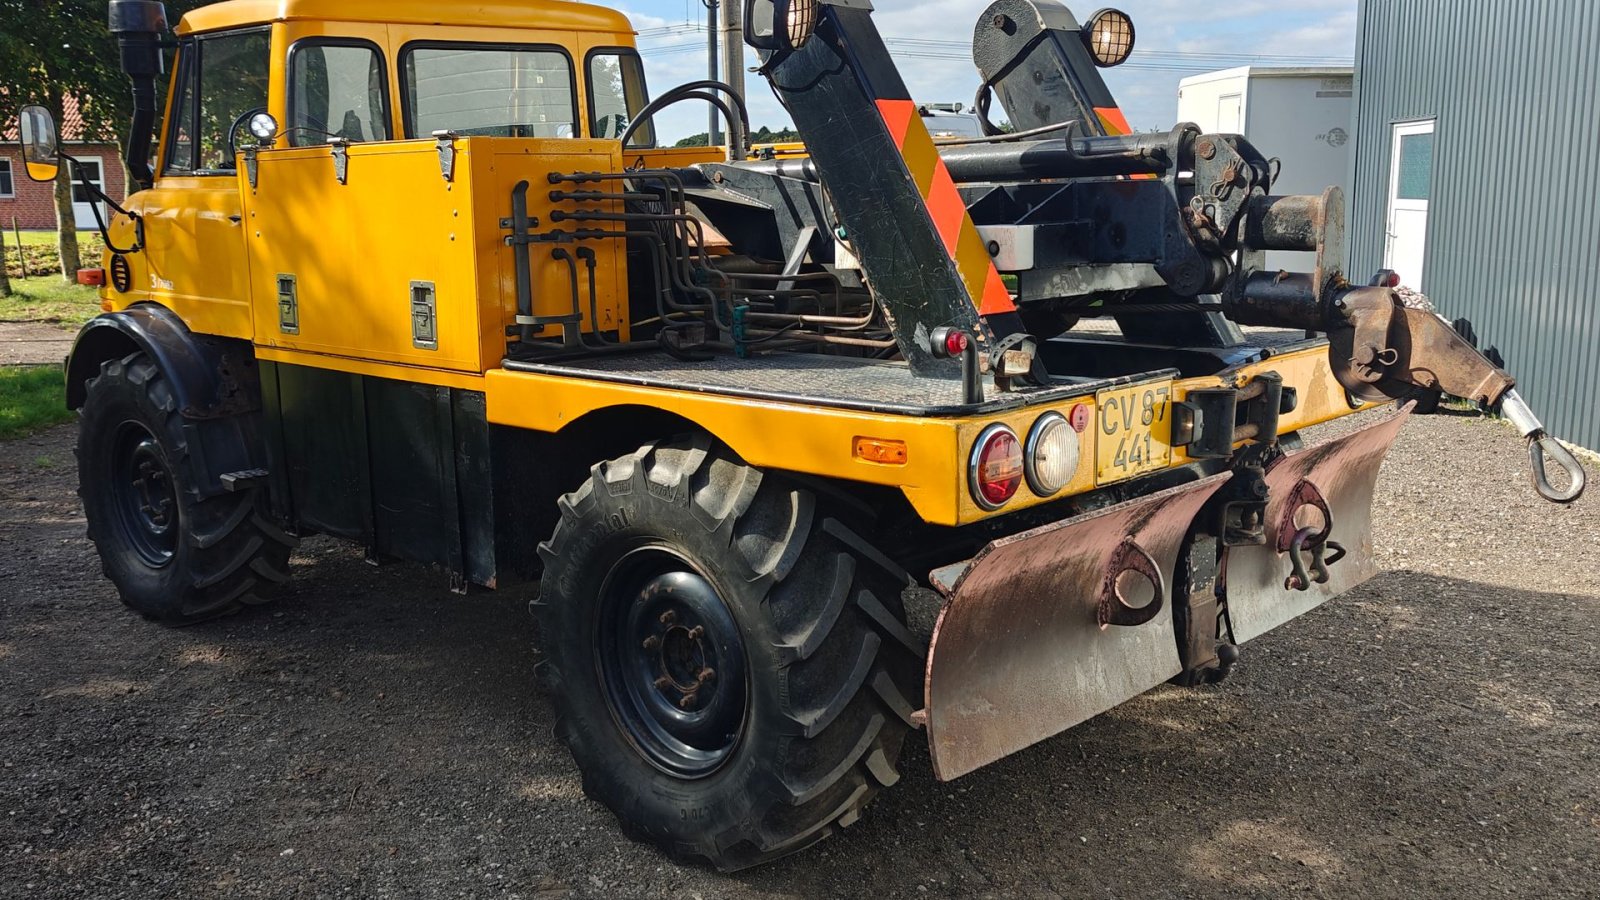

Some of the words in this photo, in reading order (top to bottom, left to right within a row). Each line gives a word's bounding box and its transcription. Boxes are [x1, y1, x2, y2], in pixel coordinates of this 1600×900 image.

[1101, 393, 1136, 435] CV
[1141, 386, 1169, 426] 87
[1113, 430, 1151, 472] 441
